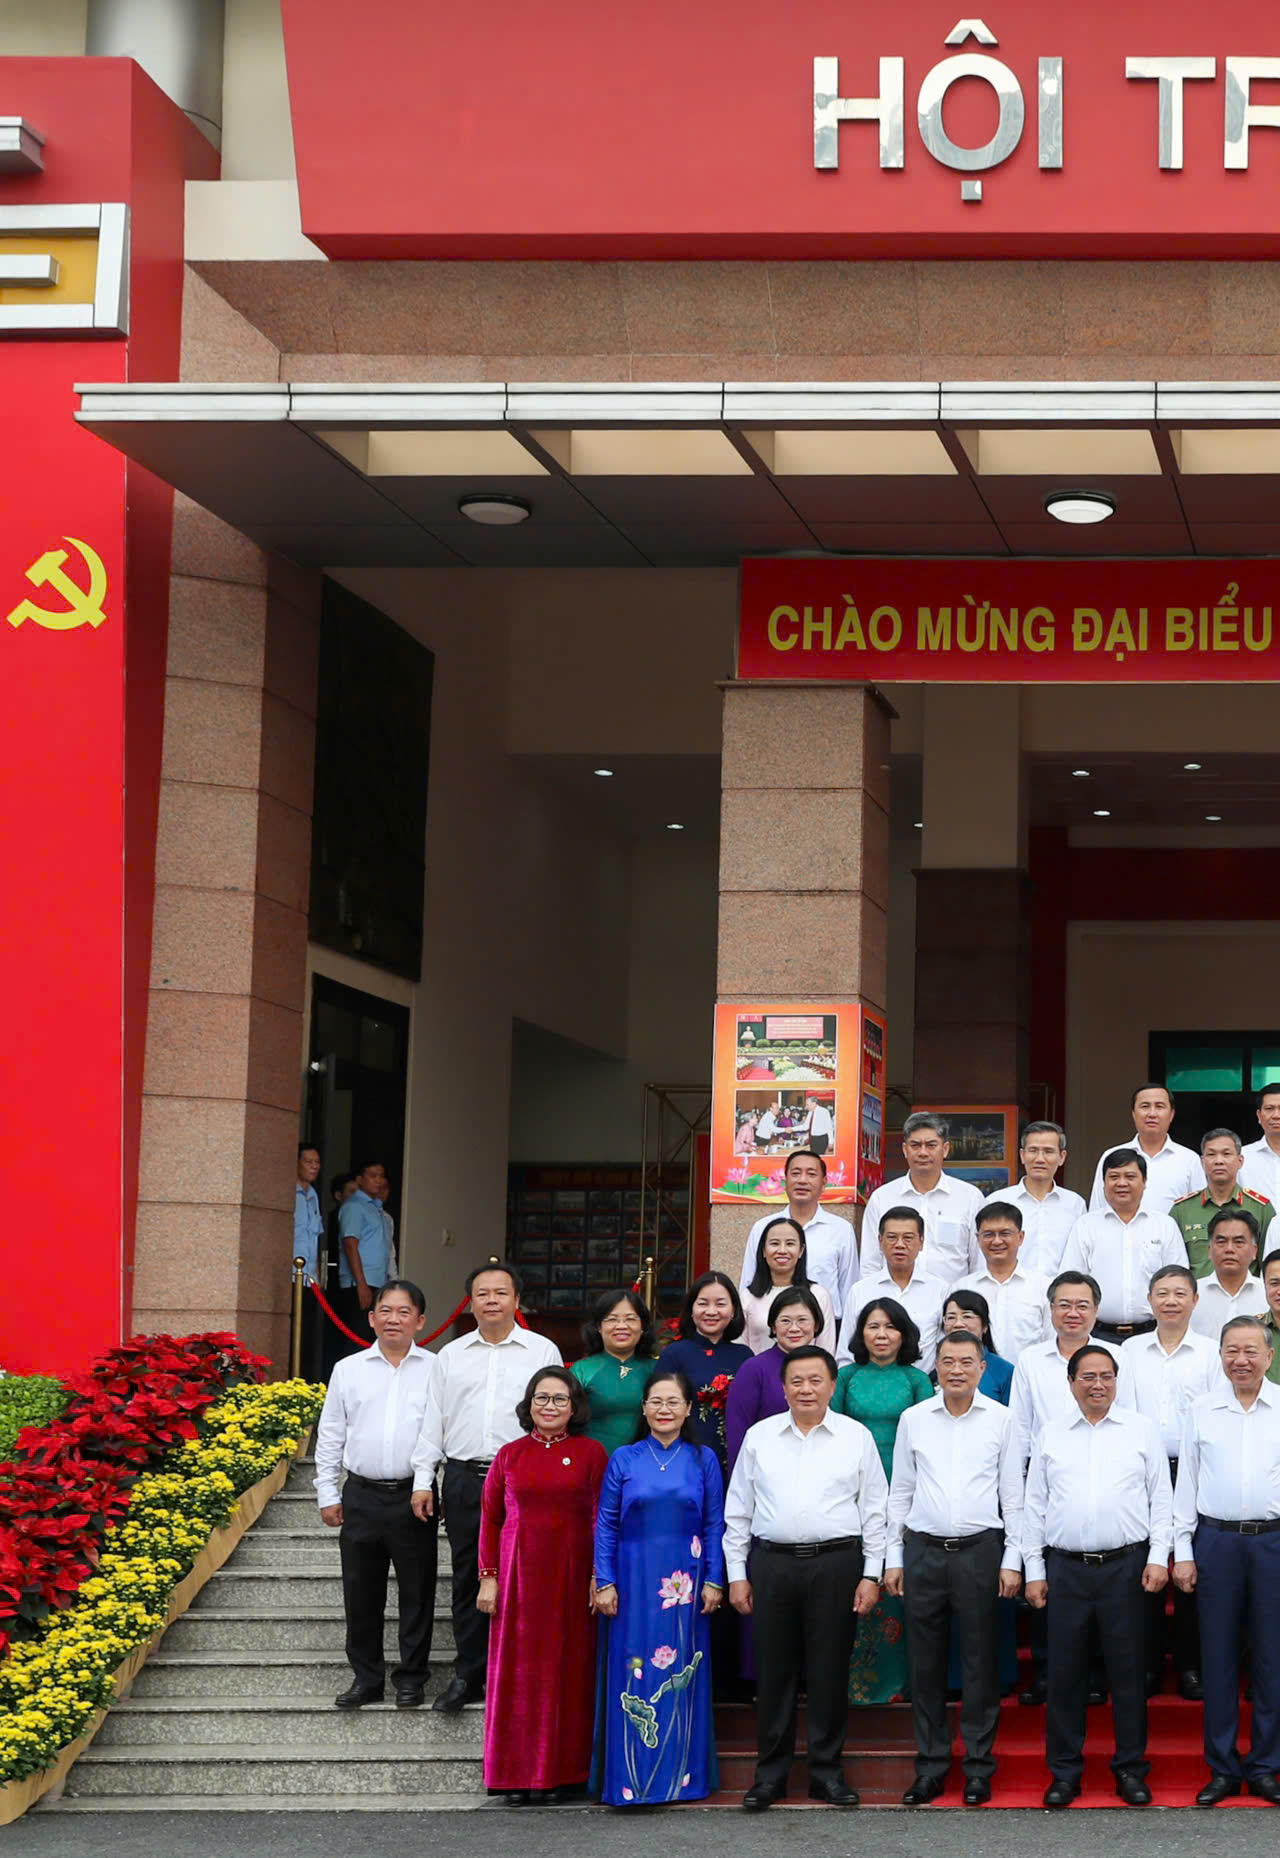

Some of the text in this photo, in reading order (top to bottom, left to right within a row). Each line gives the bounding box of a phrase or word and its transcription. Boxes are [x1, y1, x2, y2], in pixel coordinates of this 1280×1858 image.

[813, 19, 1064, 201] HỘI
[767, 594, 902, 652] CHÀO
[917, 594, 1055, 652] MỪNG
[1071, 607, 1148, 662] ĐẠI
[1165, 582, 1272, 652] BIỂU
